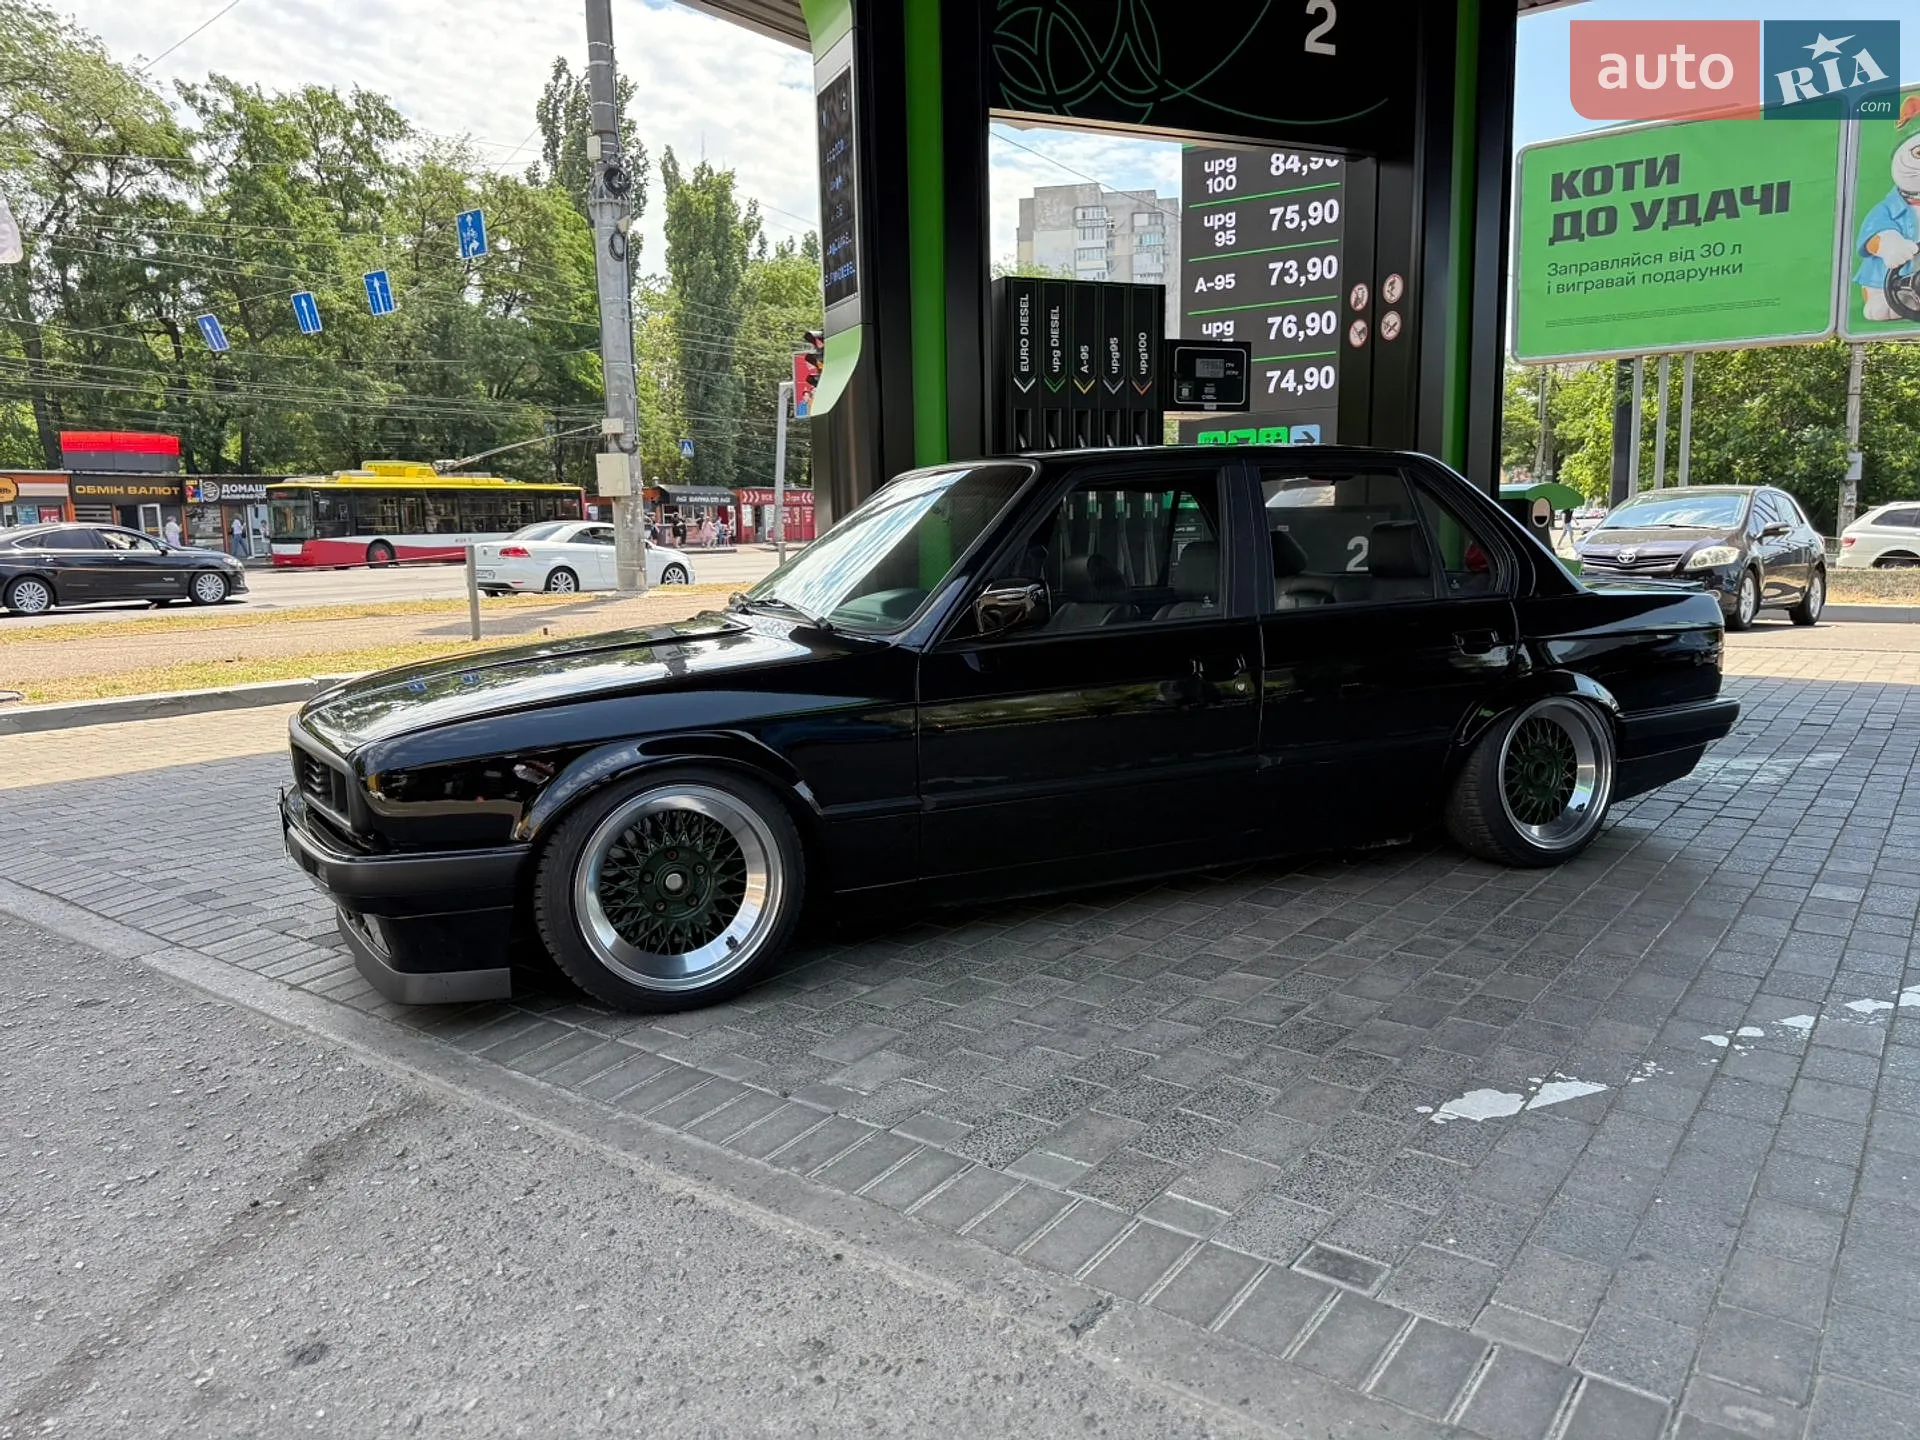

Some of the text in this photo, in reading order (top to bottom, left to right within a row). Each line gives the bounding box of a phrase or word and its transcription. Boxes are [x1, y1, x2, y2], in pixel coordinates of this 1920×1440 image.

[1304, 0, 1337, 56] 2
[1204, 157, 1237, 173] upg
[1551, 153, 1681, 202] КОТИ
[1206, 174, 1237, 194] 100
[1203, 198, 1340, 232] upg 75,90
[1548, 181, 1791, 246] ДО УДАЧІ
[1214, 229, 1236, 247] 95
[1268, 254, 1339, 288] 73,90
[1547, 242, 1743, 277] Заправляйся від 30 л
[1546, 262, 1743, 295] і вигравай подарунки
[1019, 293, 1030, 372] EURO DIESEL
[1050, 305, 1062, 373] upg DIESEL
[1201, 310, 1337, 342] upg 76,90
[1109, 337, 1121, 374] upg95
[1138, 332, 1149, 375] upg100
[1266, 365, 1336, 396] 74,90
[75, 485, 180, 495] ОБМІН ВАЛЮТ
[1345, 535, 1369, 572] 2
